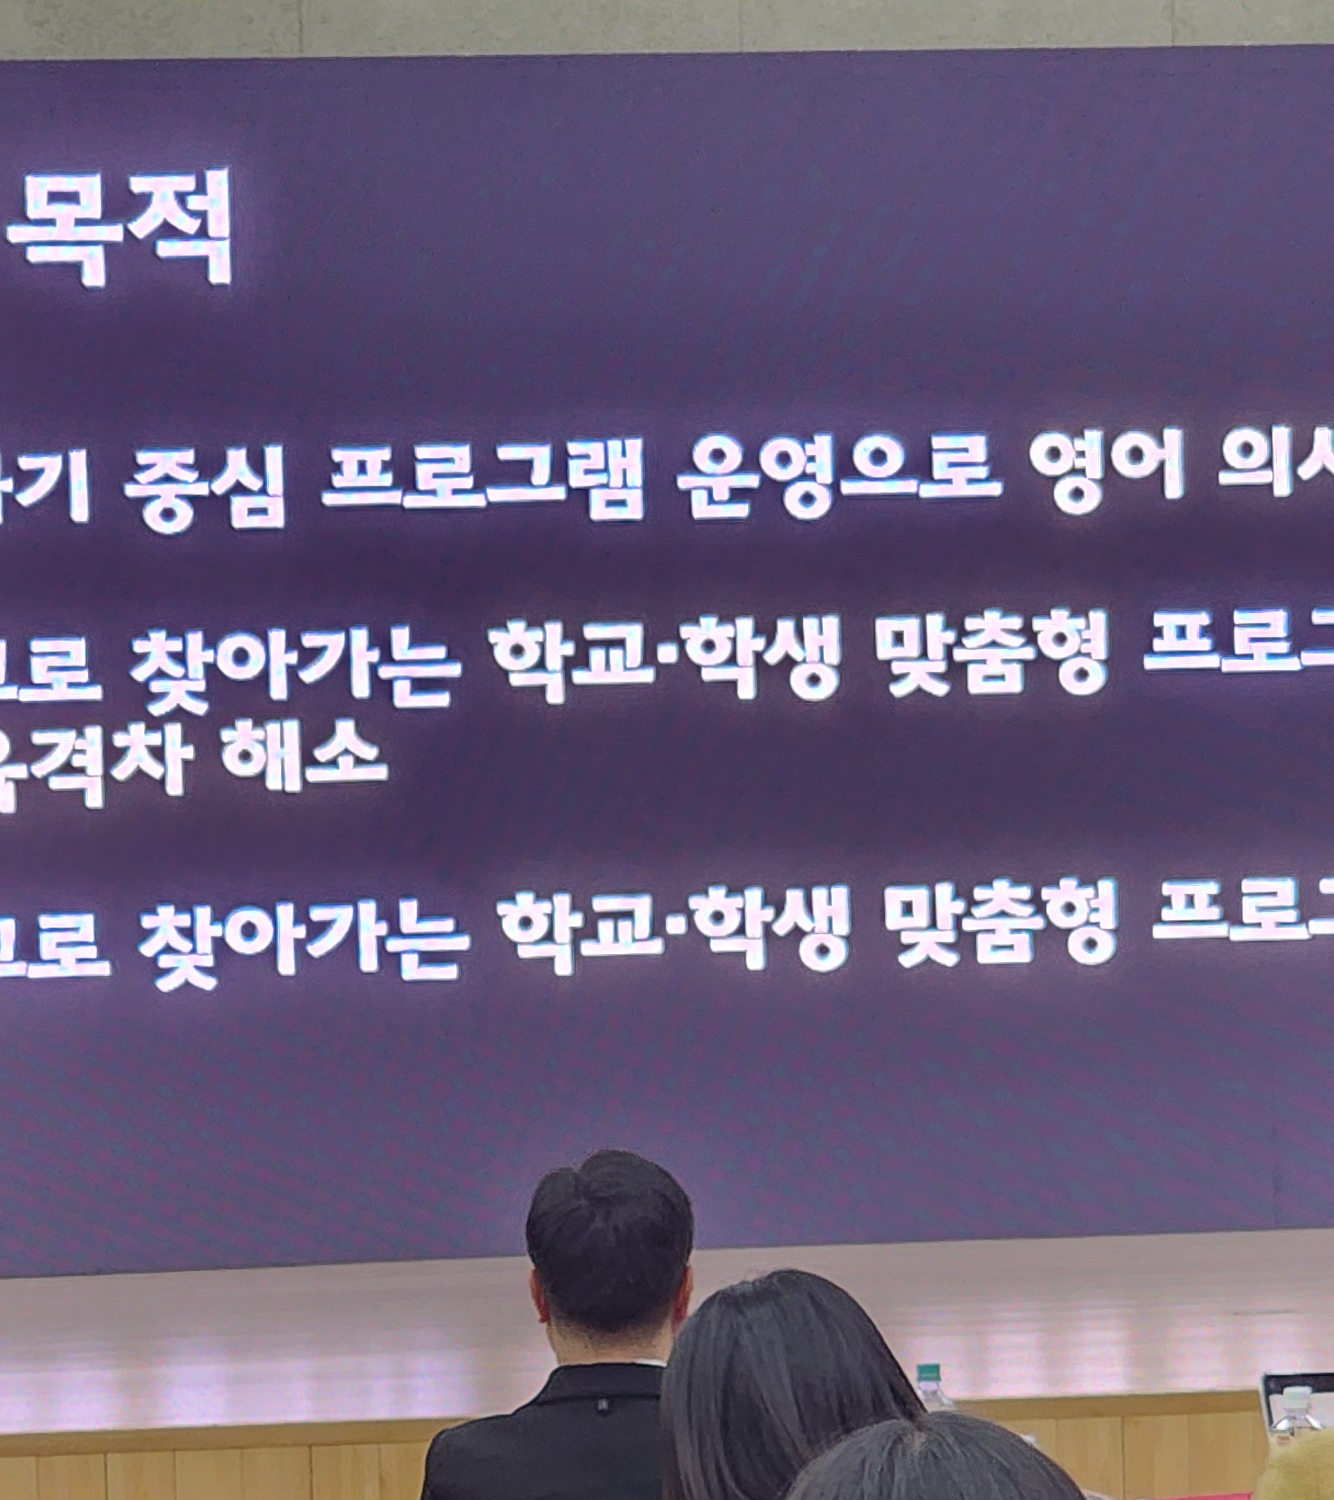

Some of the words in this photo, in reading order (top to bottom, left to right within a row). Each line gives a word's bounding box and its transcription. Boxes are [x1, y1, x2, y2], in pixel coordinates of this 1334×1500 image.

[7, 168, 231, 287] 목적
[125, 446, 284, 534] 중심
[322, 438, 643, 520] 프로그램
[678, 433, 1002, 519] 운영으로
[1030, 429, 1183, 514] 영어
[131, 627, 461, 716] 찾아가는
[489, 616, 840, 703] 학교·학생
[876, 609, 1106, 697] 맞춤형
[221, 719, 387, 791] 해소
[139, 900, 470, 992] 찾아가는
[497, 886, 849, 975] 학교·학생
[885, 878, 1116, 968] 맞춤형
